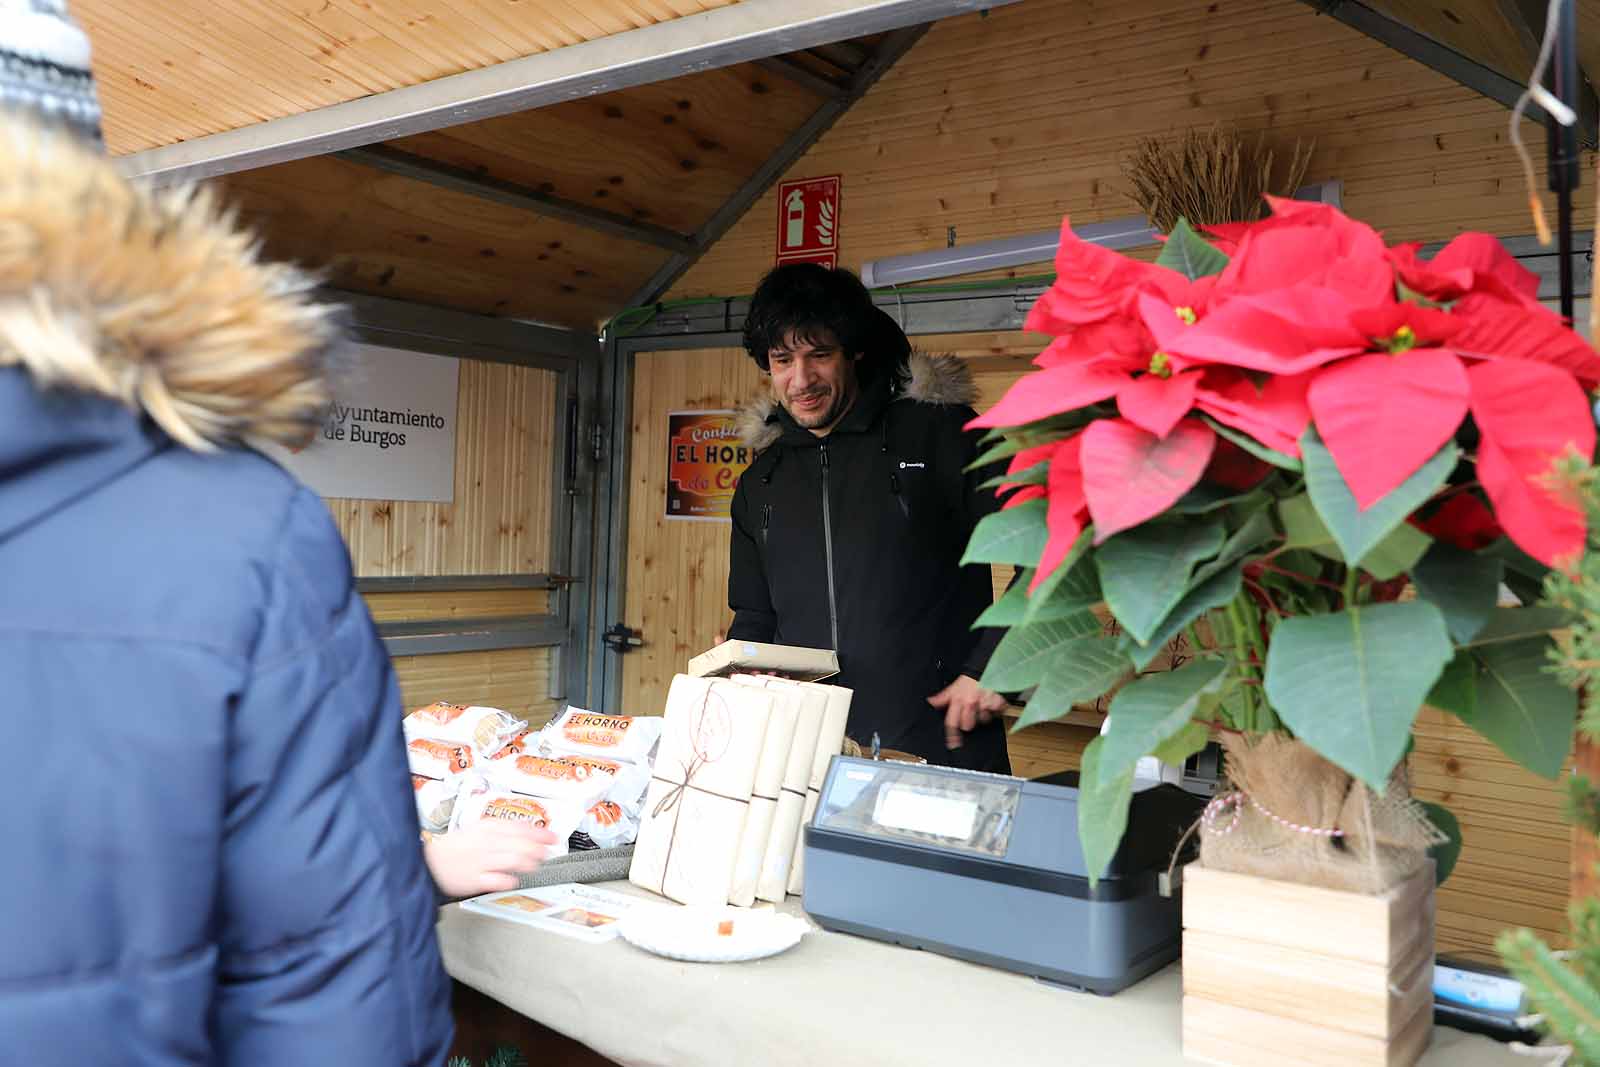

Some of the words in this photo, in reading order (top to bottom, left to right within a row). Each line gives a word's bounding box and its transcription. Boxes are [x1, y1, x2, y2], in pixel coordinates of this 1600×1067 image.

[328, 400, 445, 429] Ayuntamiento
[324, 422, 345, 441] de
[350, 423, 406, 449] Burgos
[676, 445, 699, 463] EL
[583, 717, 629, 730] HORNO
